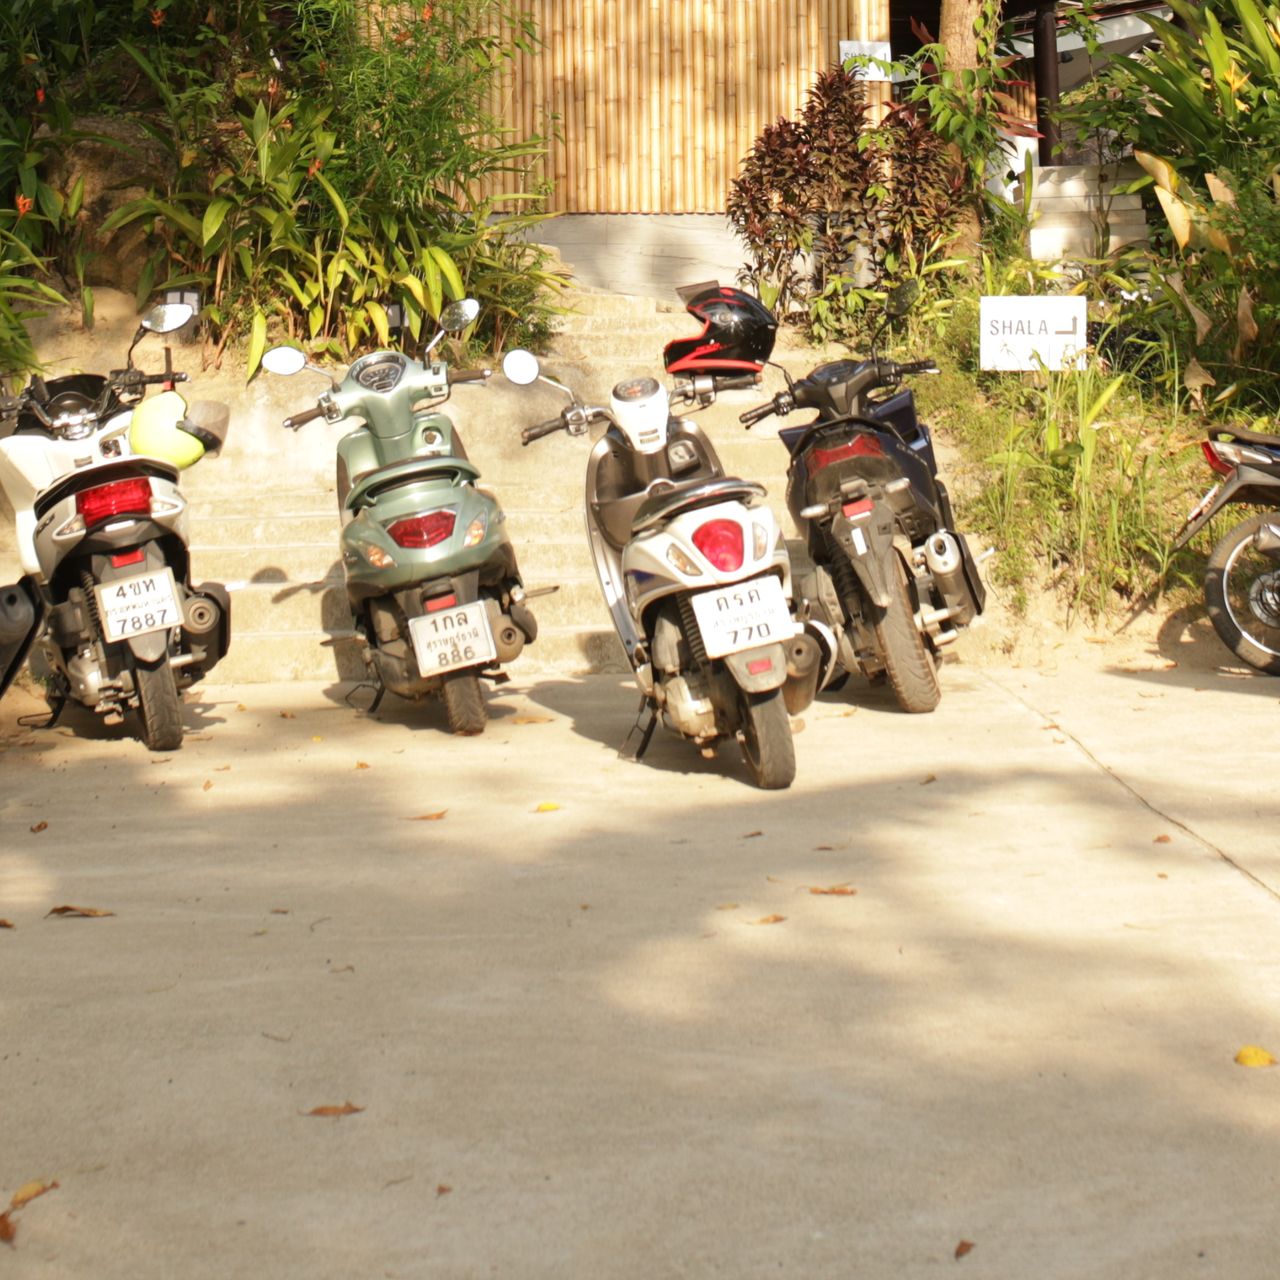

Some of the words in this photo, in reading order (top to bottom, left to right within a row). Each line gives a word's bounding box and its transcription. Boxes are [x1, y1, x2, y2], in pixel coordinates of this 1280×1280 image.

[990, 319, 1048, 336] SHALA
[116, 609, 168, 634] 7887
[727, 623, 771, 645] 770
[438, 646, 476, 667] 886
